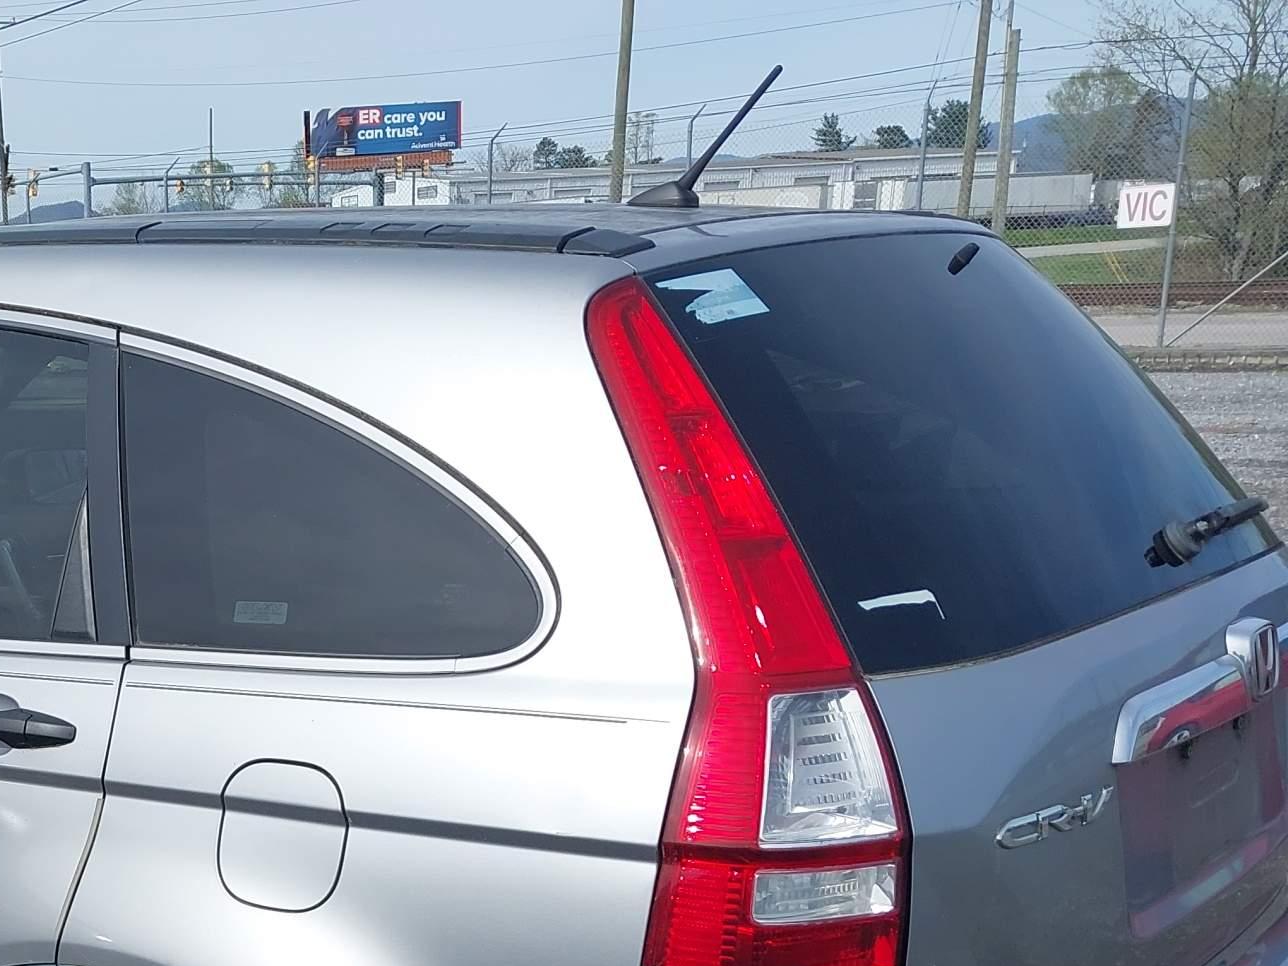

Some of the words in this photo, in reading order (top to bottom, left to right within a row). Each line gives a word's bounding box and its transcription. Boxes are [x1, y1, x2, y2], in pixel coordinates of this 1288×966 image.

[358, 109, 381, 124] ER
[383, 112, 416, 124] care
[419, 110, 446, 125] you
[357, 128, 384, 140] can
[385, 124, 423, 138] trust.
[1125, 190, 1169, 223] VIC
[994, 785, 1114, 850] CR-V
